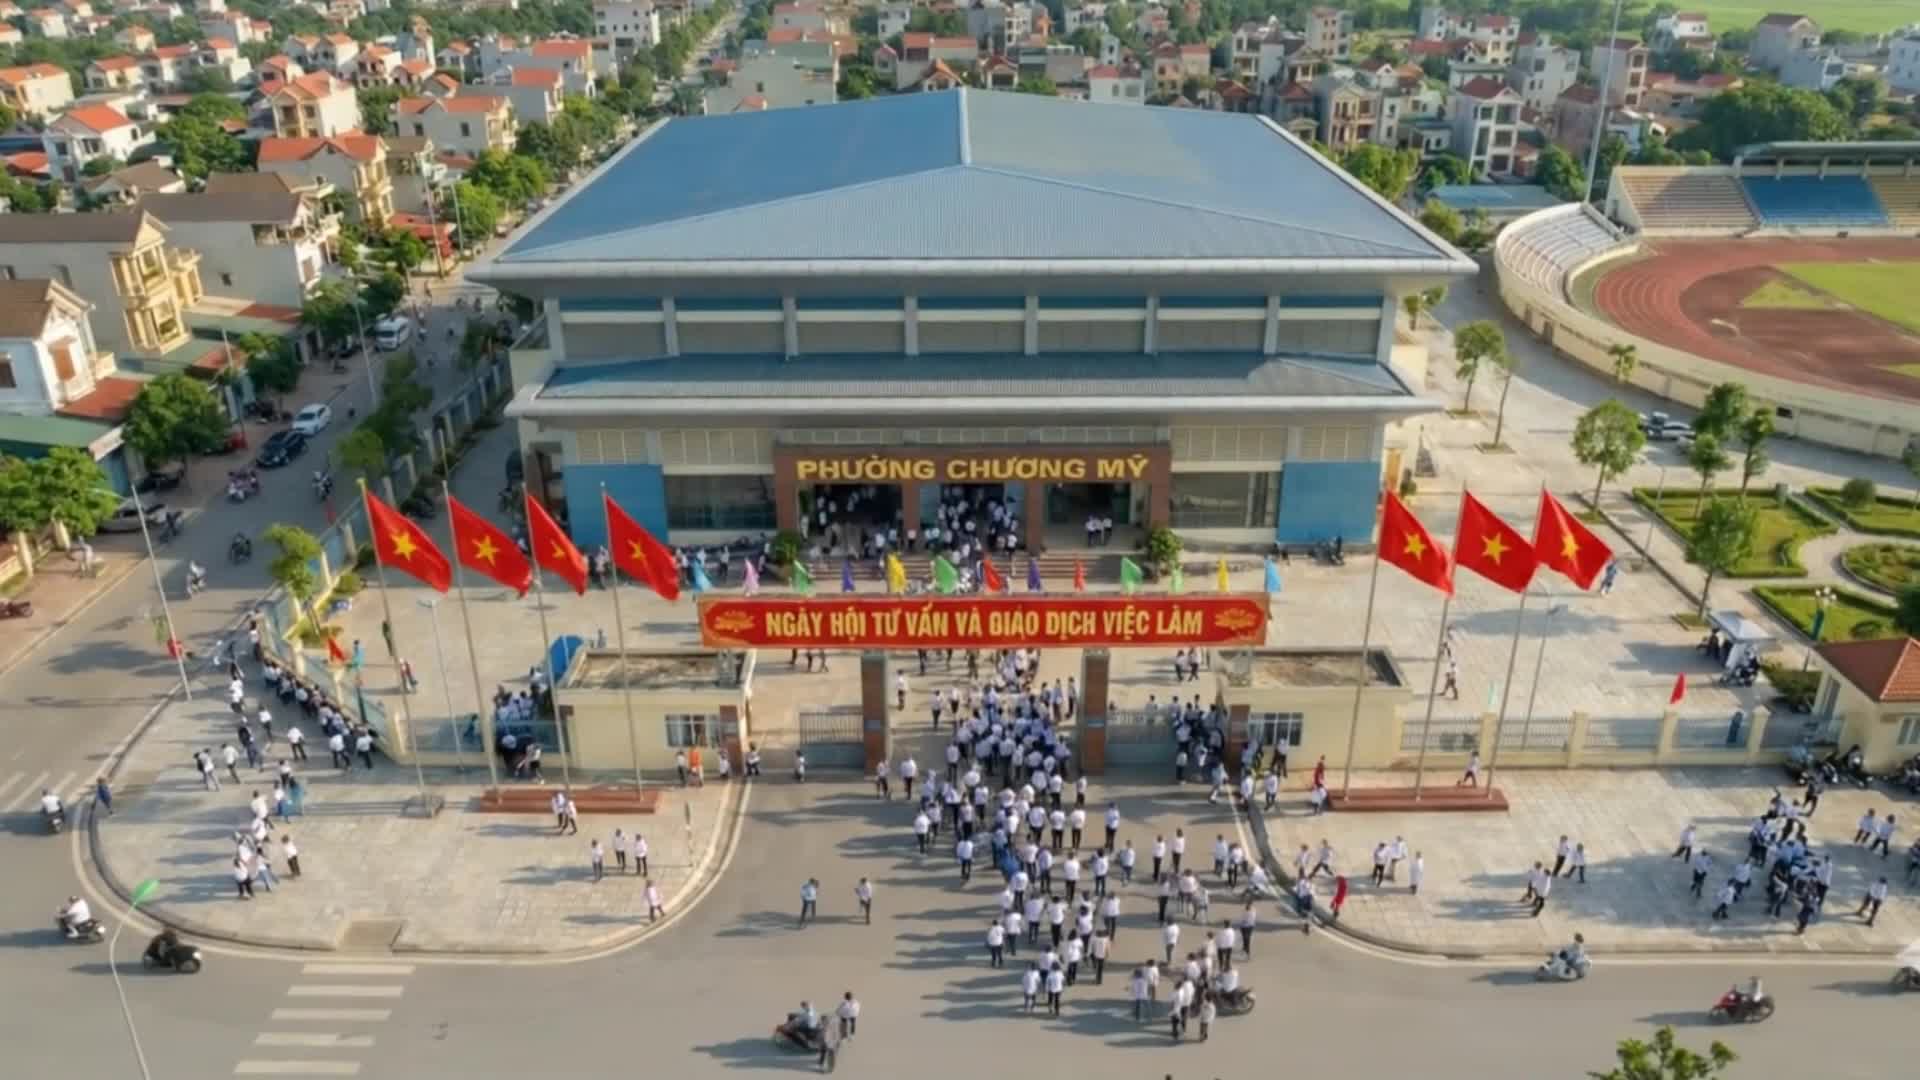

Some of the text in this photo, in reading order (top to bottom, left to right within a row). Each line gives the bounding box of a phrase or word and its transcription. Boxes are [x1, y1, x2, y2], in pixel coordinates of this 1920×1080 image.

[796, 454, 1148, 480] PHƯỜNG CHƯƠNG MỸ
[765, 606, 823, 637] NGÀY
[830, 606, 867, 642] HỘI
[872, 608, 902, 637] TƯ
[905, 603, 949, 637] VẤN
[954, 606, 983, 637] VÀ
[1045, 610, 1097, 640] DỊCH
[1103, 605, 1150, 640] VIỆC
[1156, 604, 1203, 636] LÀM
